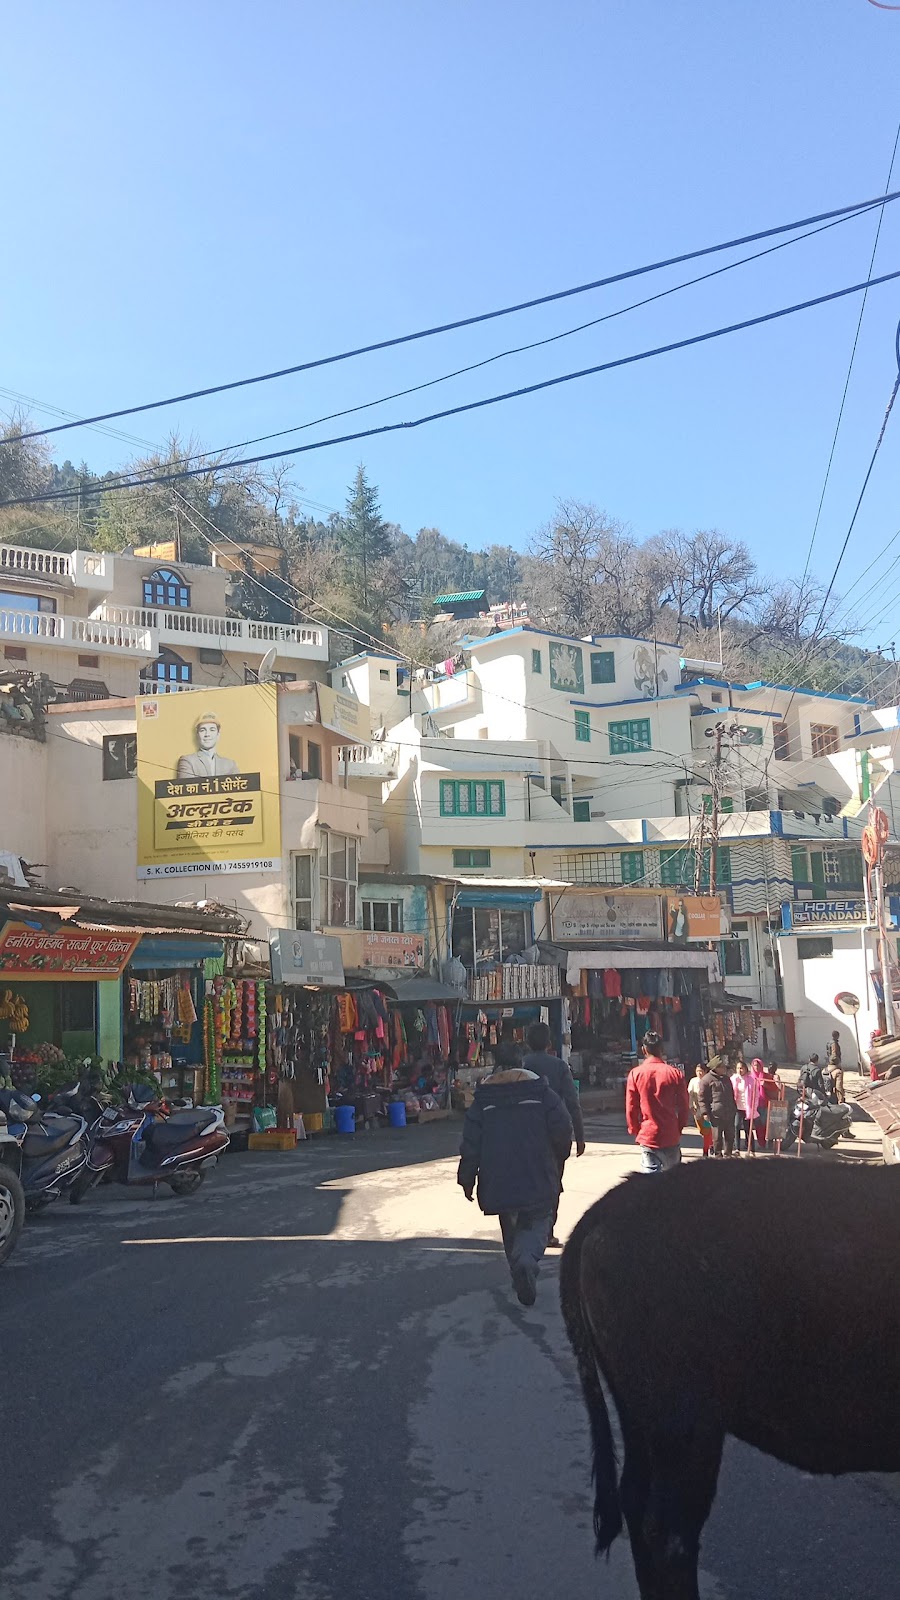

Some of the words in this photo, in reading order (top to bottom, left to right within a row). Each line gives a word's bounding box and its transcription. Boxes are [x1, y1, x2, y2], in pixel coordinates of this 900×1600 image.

[167, 782, 183, 795] देश
[186, 783, 199, 794] का
[166, 797, 254, 819] अल्ट्राटेक
[211, 829, 224, 838] की
[164, 864, 211, 874] COLLECTION
[212, 863, 227, 872] (M.)
[228, 861, 273, 870] 7455919108
[804, 901, 854, 912] HOTEL
[5, 932, 38, 948] हनीफ
[35, 937, 67, 949] अहमद
